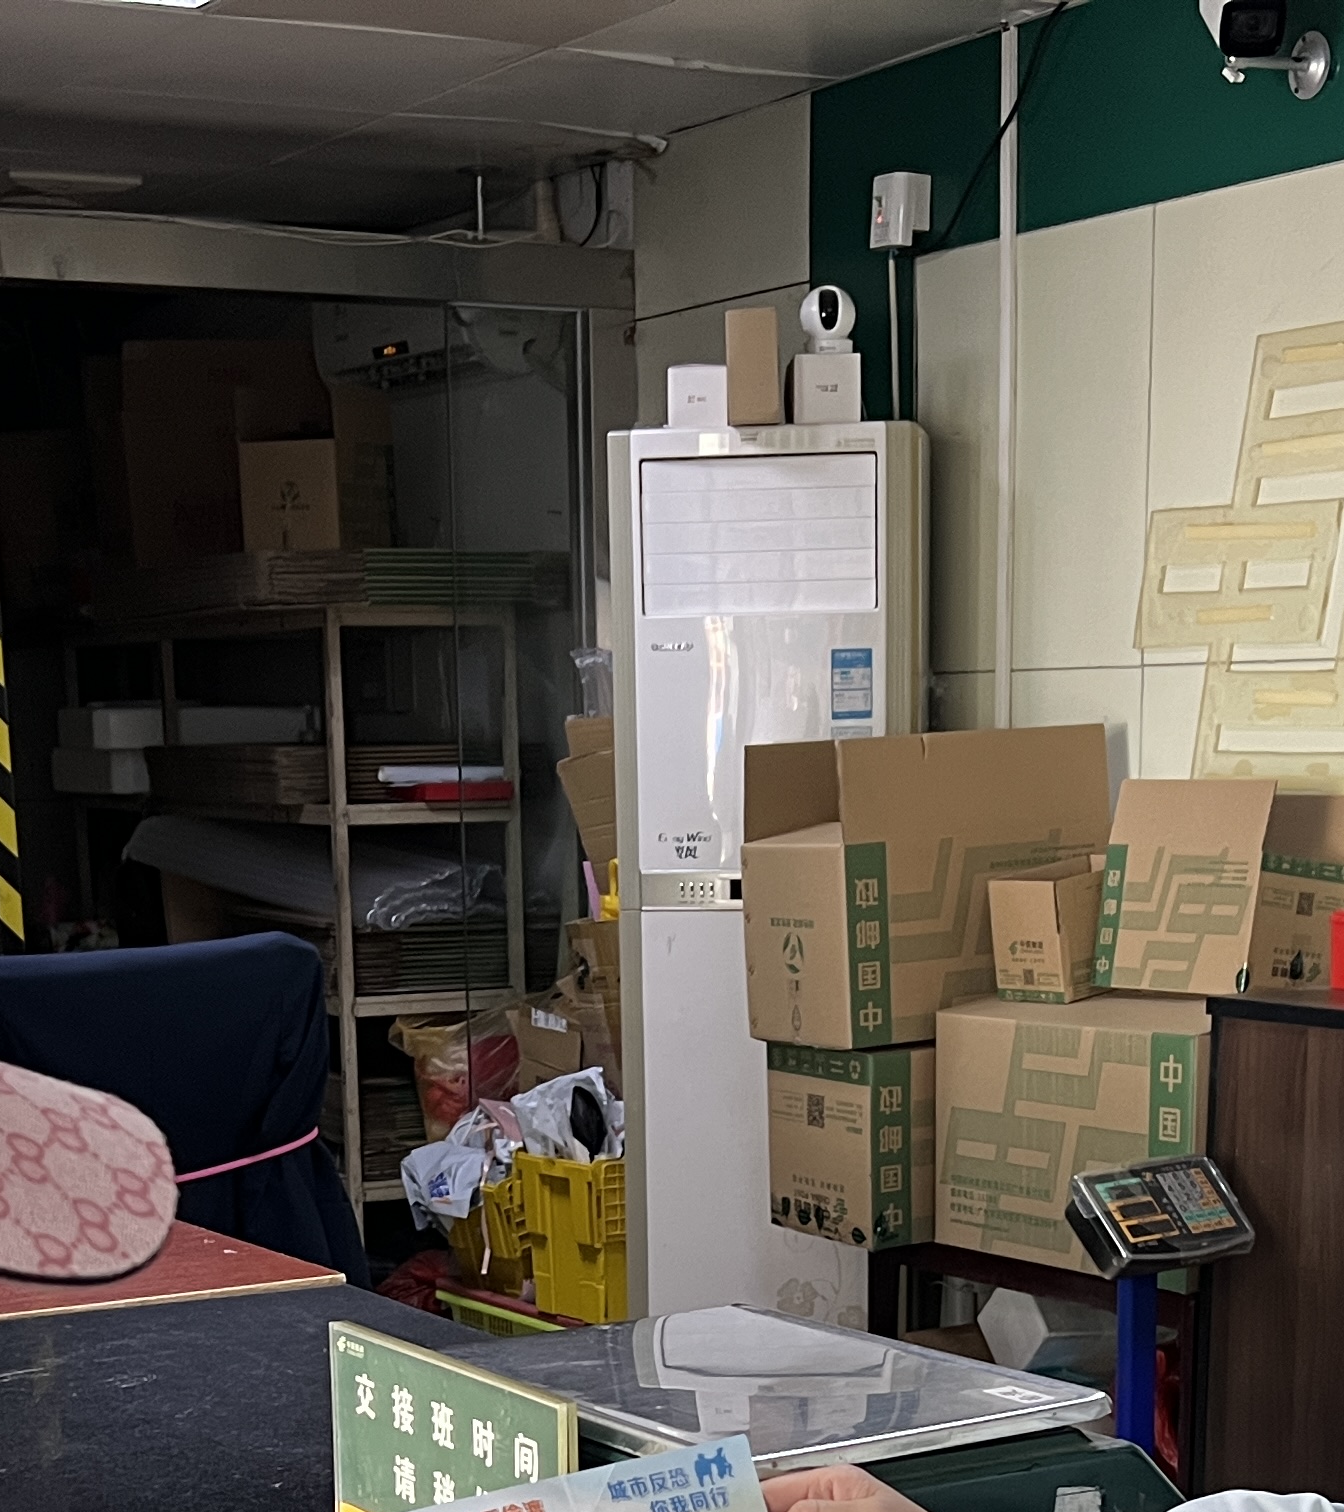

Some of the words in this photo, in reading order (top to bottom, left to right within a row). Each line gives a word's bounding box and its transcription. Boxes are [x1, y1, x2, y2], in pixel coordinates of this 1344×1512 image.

[1158, 1053, 1183, 1143] 中国
[354, 1373, 539, 1484] 交接班时间
[393, 1454, 489, 1505] 请稍
[607, 1467, 690, 1502] 城市反恐
